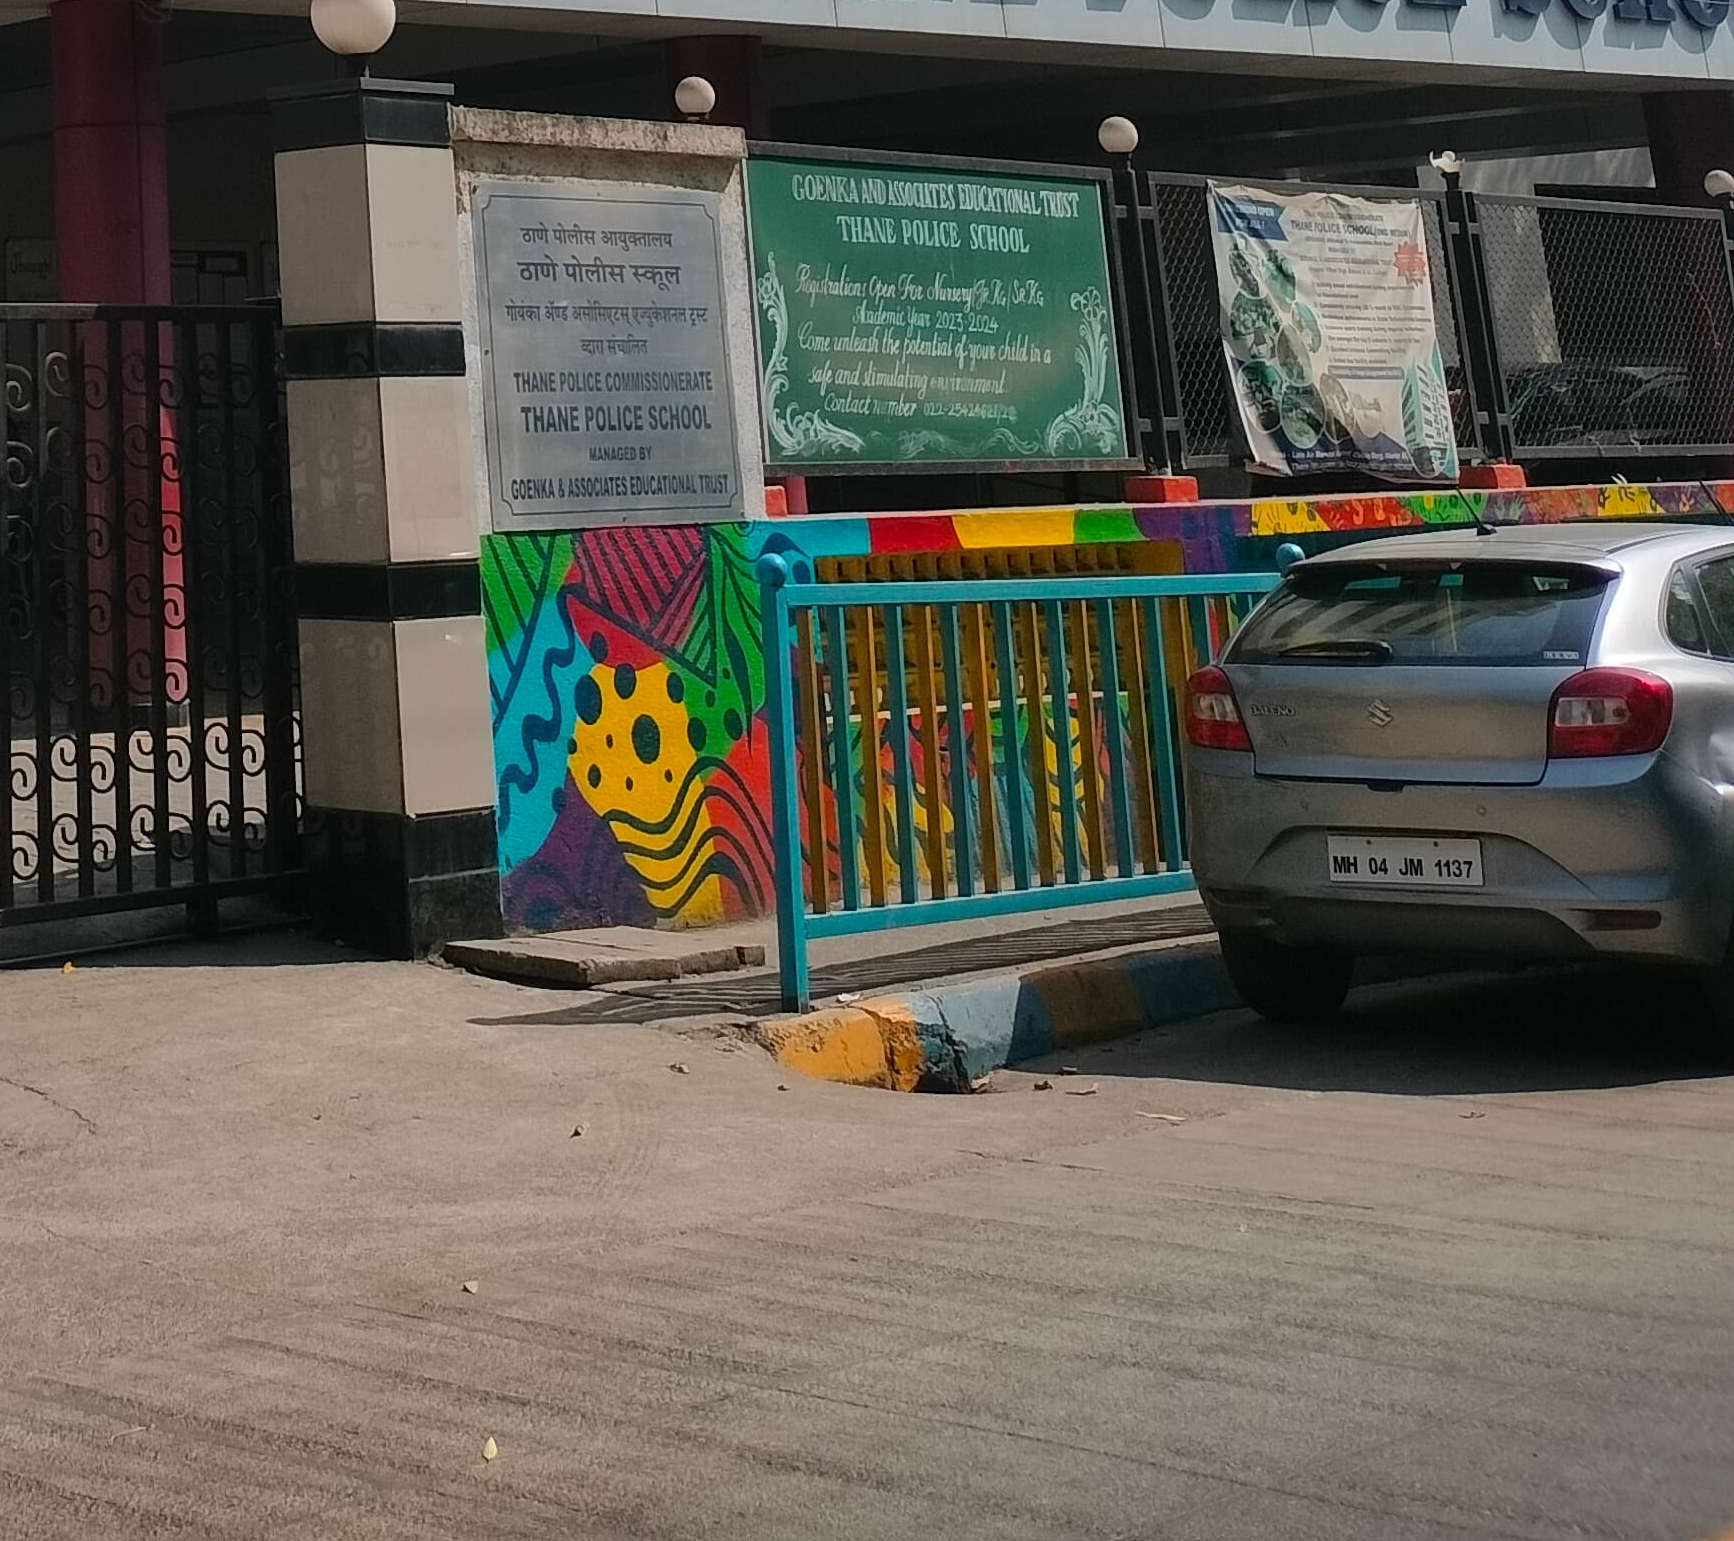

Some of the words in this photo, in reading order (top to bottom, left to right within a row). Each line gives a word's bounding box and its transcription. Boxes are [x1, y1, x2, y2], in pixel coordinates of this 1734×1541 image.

[792, 174, 860, 205] GOENKA
[861, 177, 887, 207] AND
[887, 179, 957, 211] ASSOCIATES
[957, 182, 1041, 216] EDUCATIONAL
[1041, 190, 1080, 218] TRUST
[520, 221, 549, 245] ठाणे
[552, 222, 596, 246] पोलीस
[601, 230, 673, 252] आयुक्तालय
[836, 216, 897, 245] THANE
[901, 219, 962, 249] POLICE
[969, 223, 1031, 254] SCHOOL
[517, 253, 558, 282] ठाणे
[563, 255, 625, 284] पोलीस
[629, 263, 682, 291] स्कूल
[868, 275, 897, 305] Open
[906, 305, 931, 337] Year
[797, 320, 831, 353] Come
[833, 326, 879, 354] unleash
[882, 326, 900, 356] the
[902, 331, 953, 365] potential
[955, 335, 968, 369] of
[968, 341, 996, 367] your
[998, 332, 1029, 363] child
[1030, 337, 1042, 363] in
[1043, 347, 1052, 364] a
[513, 371, 557, 394] THANE
[560, 370, 602, 392] POLICE
[605, 370, 714, 393] COMMISSIONERATE
[808, 360, 833, 397] safe
[834, 360, 860, 386] and
[862, 360, 928, 400] stimulating
[824, 388, 871, 415] Contact
[520, 405, 581, 434] THANE
[585, 404, 645, 432] POLICE
[647, 403, 713, 432] SCHOOL
[589, 446, 637, 462] MANAGED
[639, 446, 653, 461] BY
[511, 477, 555, 501] GOENKA
[558, 477, 566, 499] &
[568, 475, 628, 498] ASSOCIATES
[630, 473, 698, 497] EDUCATIONAL
[698, 473, 730, 495] TRUST
[1333, 856, 1358, 874] MH
[1368, 857, 1389, 875] 04
[1399, 857, 1424, 877] JM
[1434, 859, 1473, 878] 1137
